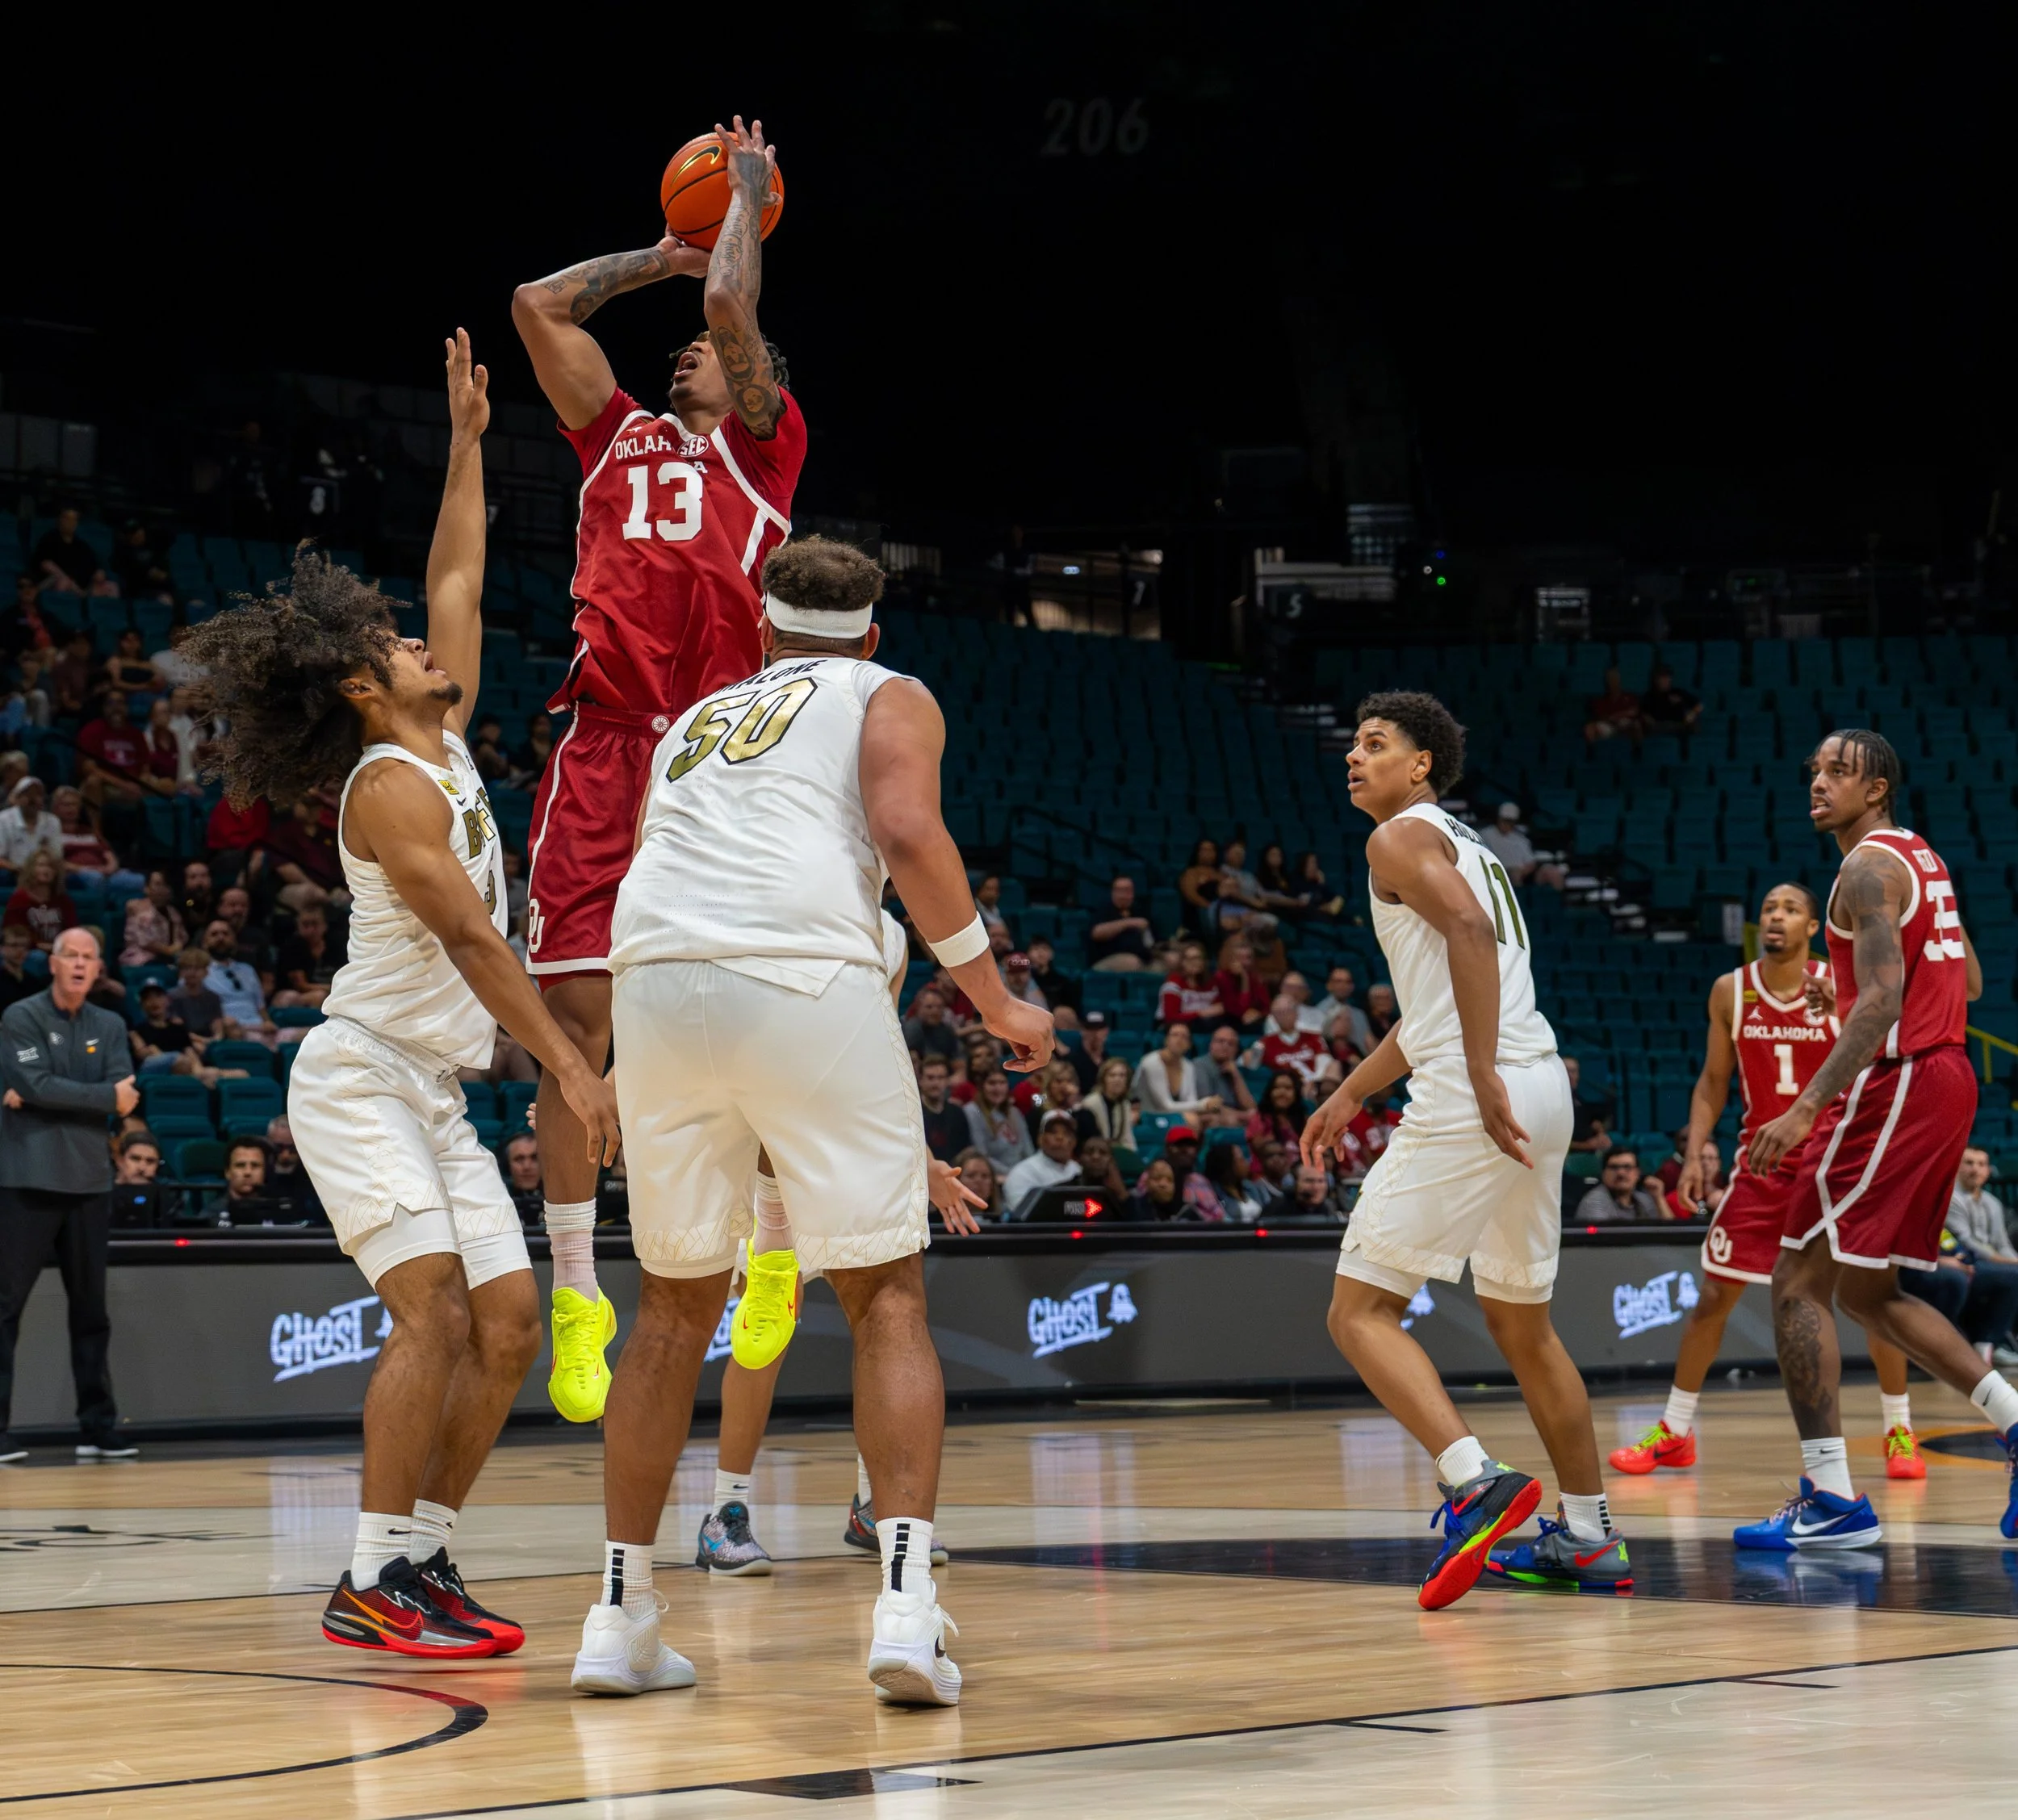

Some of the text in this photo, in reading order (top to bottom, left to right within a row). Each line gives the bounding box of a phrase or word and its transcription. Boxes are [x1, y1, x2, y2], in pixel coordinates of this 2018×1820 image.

[1040, 96, 1150, 157] 206
[679, 437, 706, 456] SEC
[622, 462, 703, 542] 13
[666, 677, 819, 783] 50
[1479, 854, 1526, 951] 11
[1744, 1024, 1828, 1043] OKLAHOMA
[1773, 1044, 1799, 1096] 1
[1710, 1225, 1733, 1264] OU
[270, 1295, 380, 1382] GHOST
[1028, 1282, 1113, 1358] GHOST
[1613, 1270, 1682, 1339] GHOST
